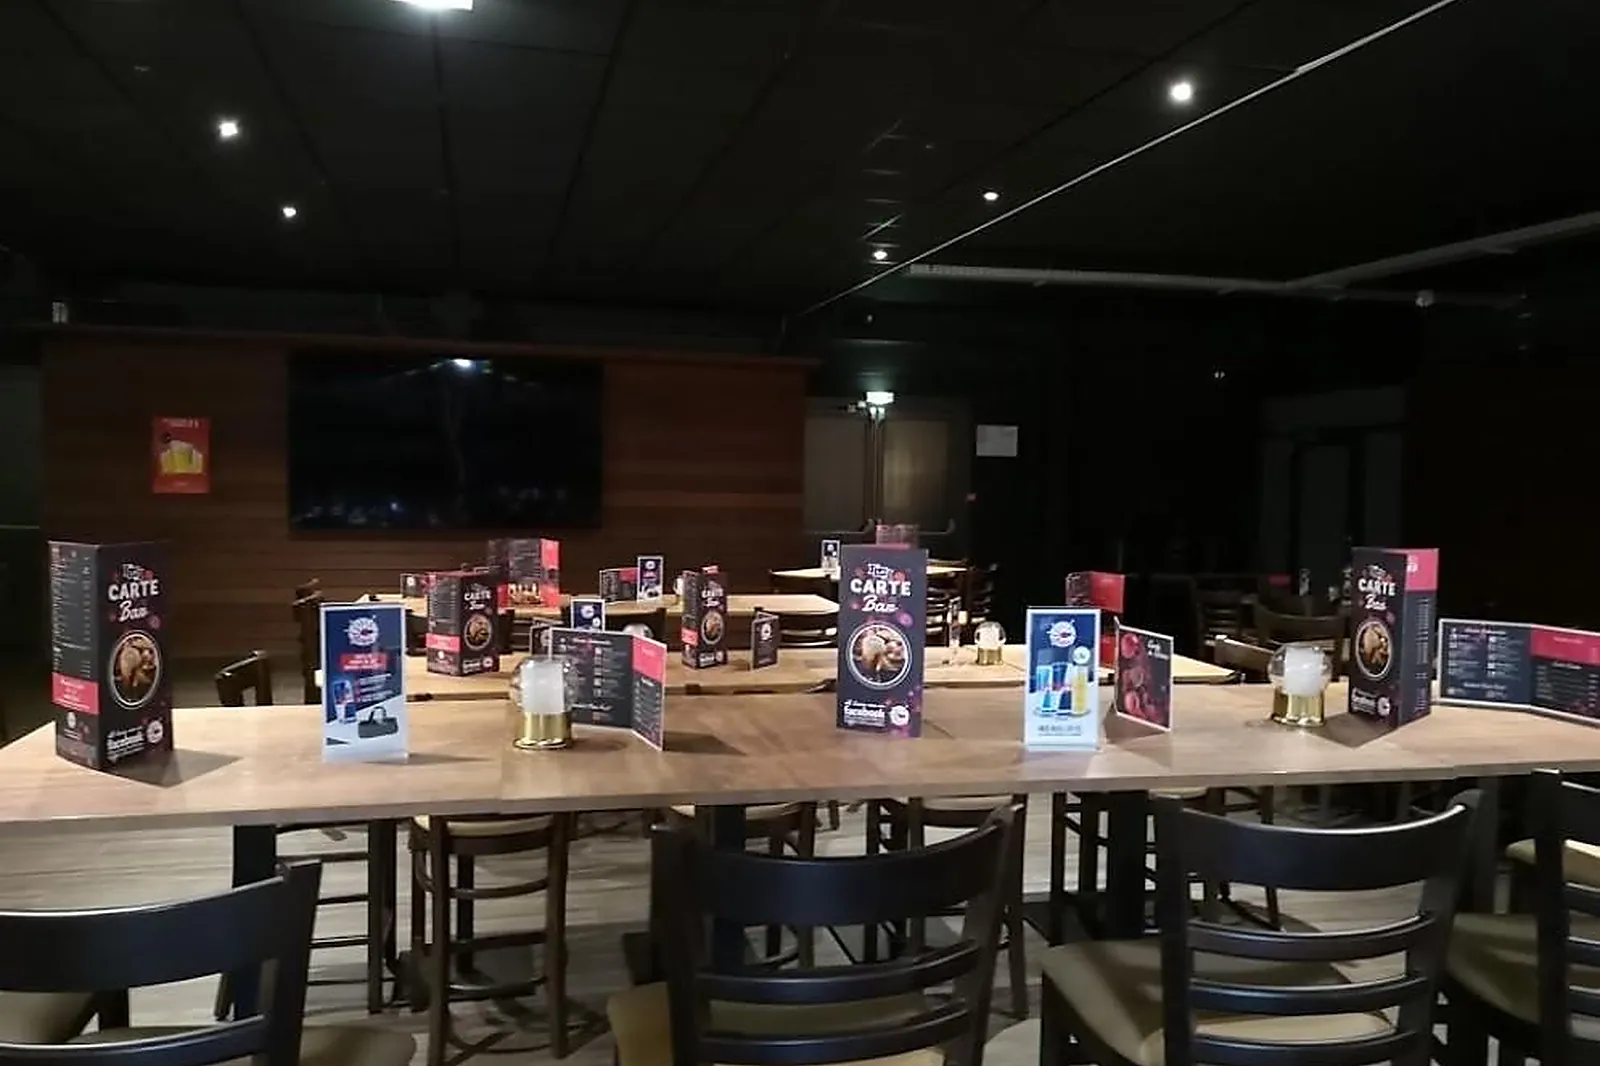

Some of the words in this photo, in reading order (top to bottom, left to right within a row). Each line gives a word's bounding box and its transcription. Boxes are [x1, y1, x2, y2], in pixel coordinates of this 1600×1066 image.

[108, 579, 159, 601] CARTE
[850, 578, 911, 597] CARTE
[1358, 578, 1396, 597] CARTE
[119, 600, 149, 621] Bar
[861, 594, 899, 613] Bar
